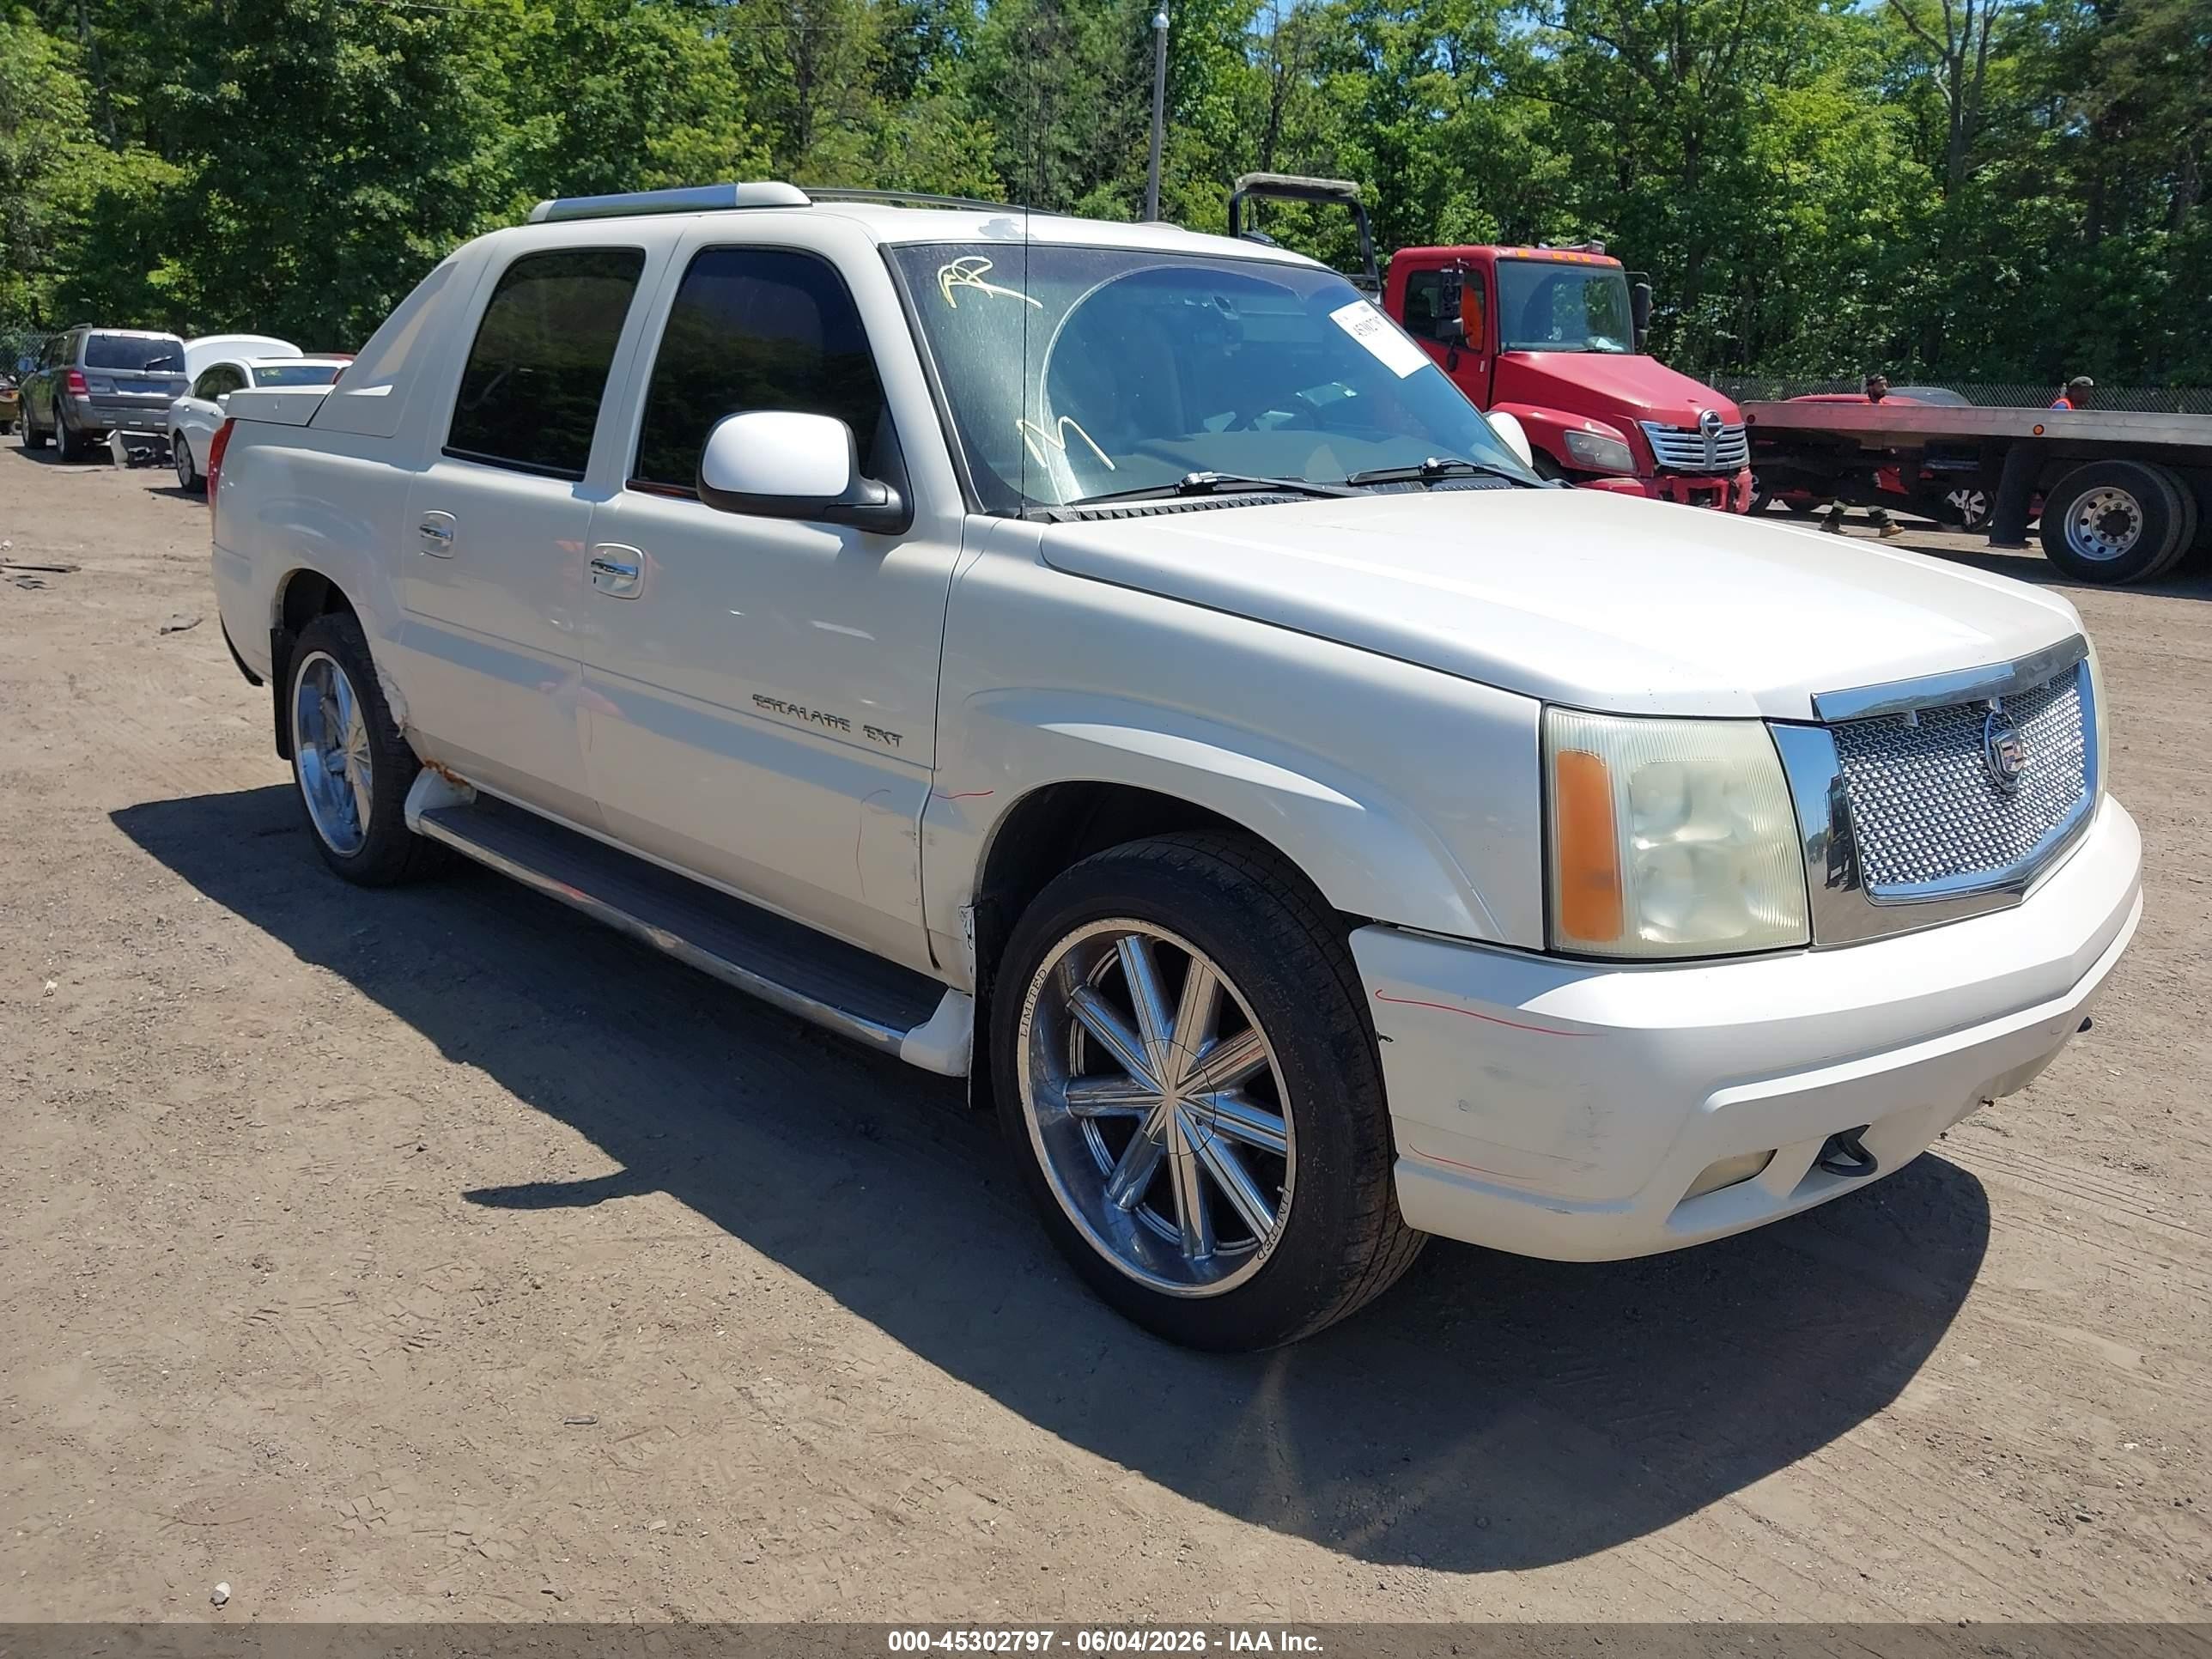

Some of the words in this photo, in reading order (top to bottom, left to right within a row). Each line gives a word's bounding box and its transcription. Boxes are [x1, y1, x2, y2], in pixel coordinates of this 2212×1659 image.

[863, 725, 903, 748] EXT
[1020, 969, 1048, 1037] LIMITED
[1256, 1188, 1291, 1260] LIMITED
